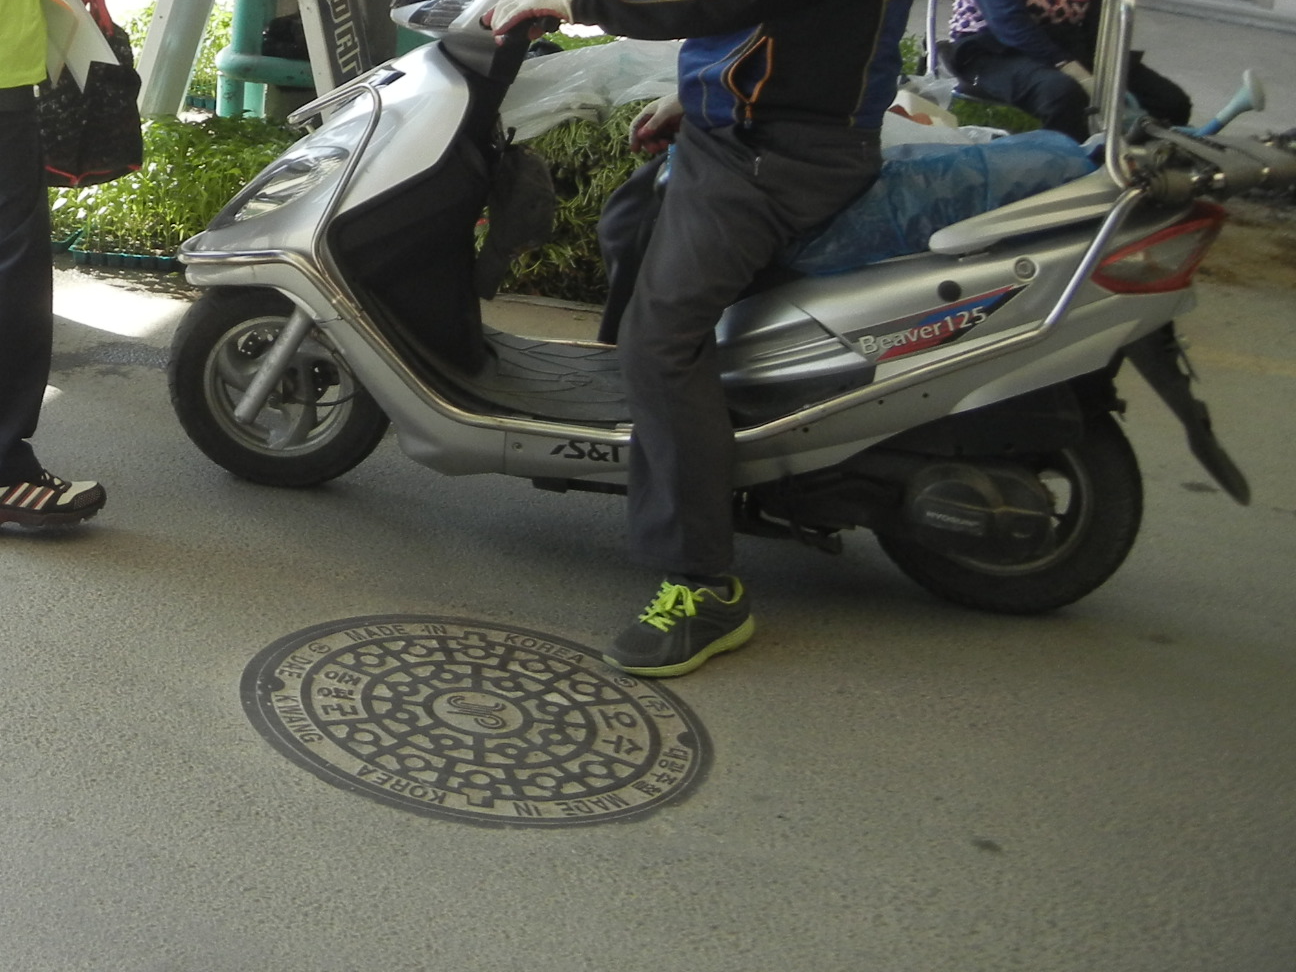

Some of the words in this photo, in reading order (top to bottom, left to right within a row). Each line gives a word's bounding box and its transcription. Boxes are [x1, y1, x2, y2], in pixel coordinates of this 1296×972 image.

[344, 624, 407, 642] MADE
[421, 624, 448, 636] IN
[505, 633, 585, 664] KOREA
[277, 654, 314, 680] DAE
[274, 694, 325, 744] KWANG
[598, 708, 644, 756] 오수
[356, 764, 447, 805] KOREA
[554, 793, 631, 816] MADE
[512, 801, 543, 817] IN
